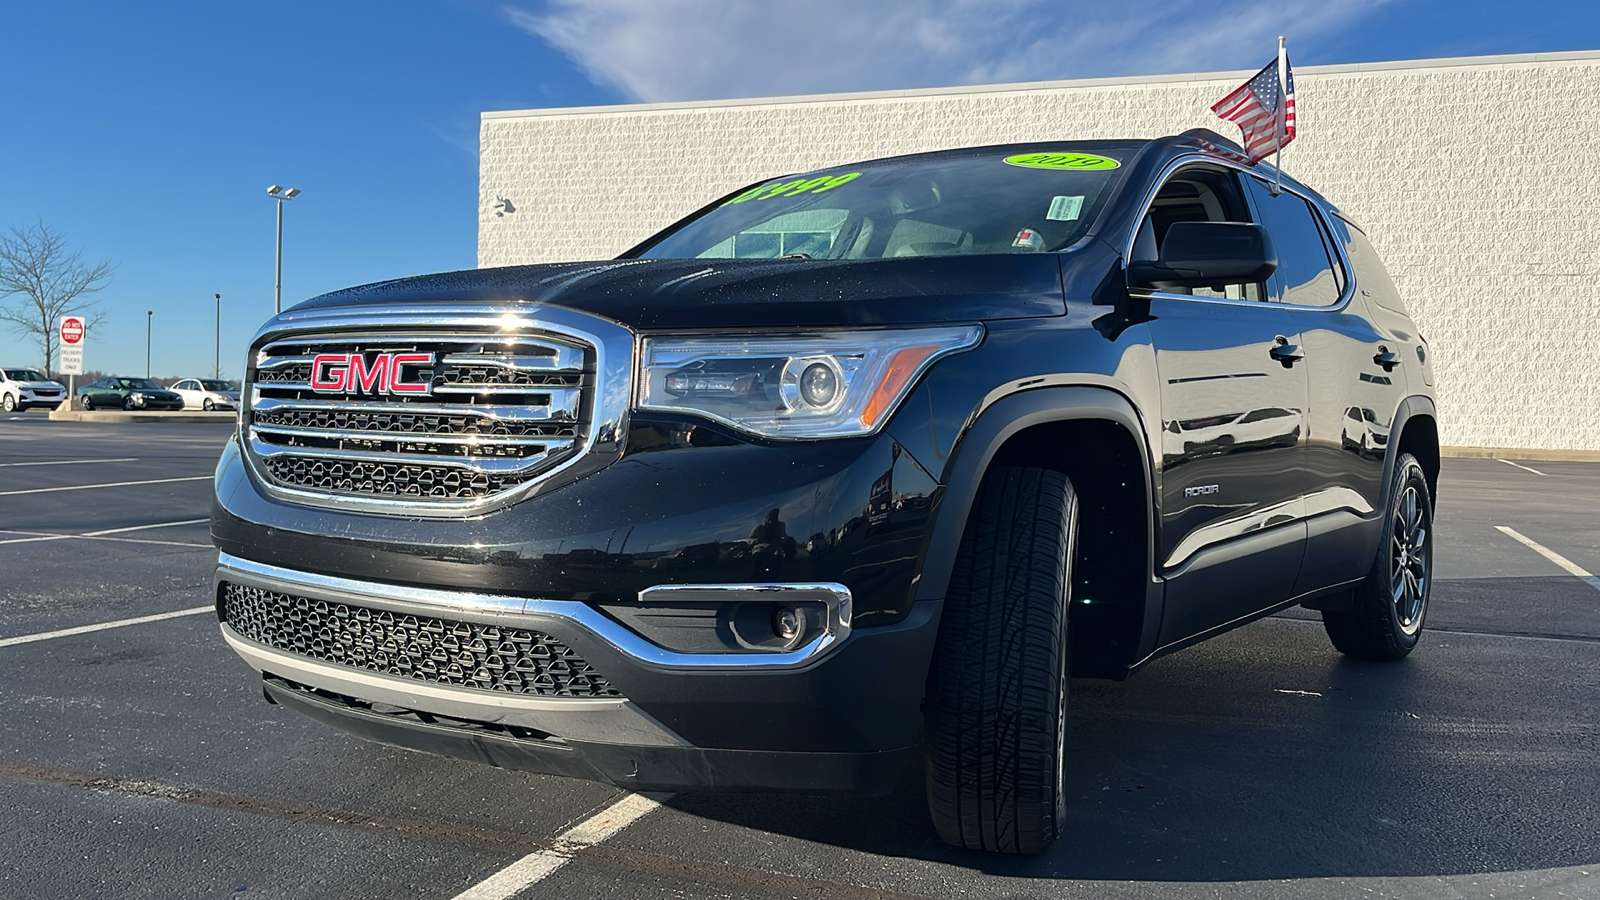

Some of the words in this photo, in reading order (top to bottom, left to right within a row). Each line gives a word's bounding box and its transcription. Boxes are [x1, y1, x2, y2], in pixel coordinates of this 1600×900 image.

[1016, 156, 1104, 167] 2019
[311, 352, 435, 396] GMC
[1184, 484, 1219, 497] ACADIA
